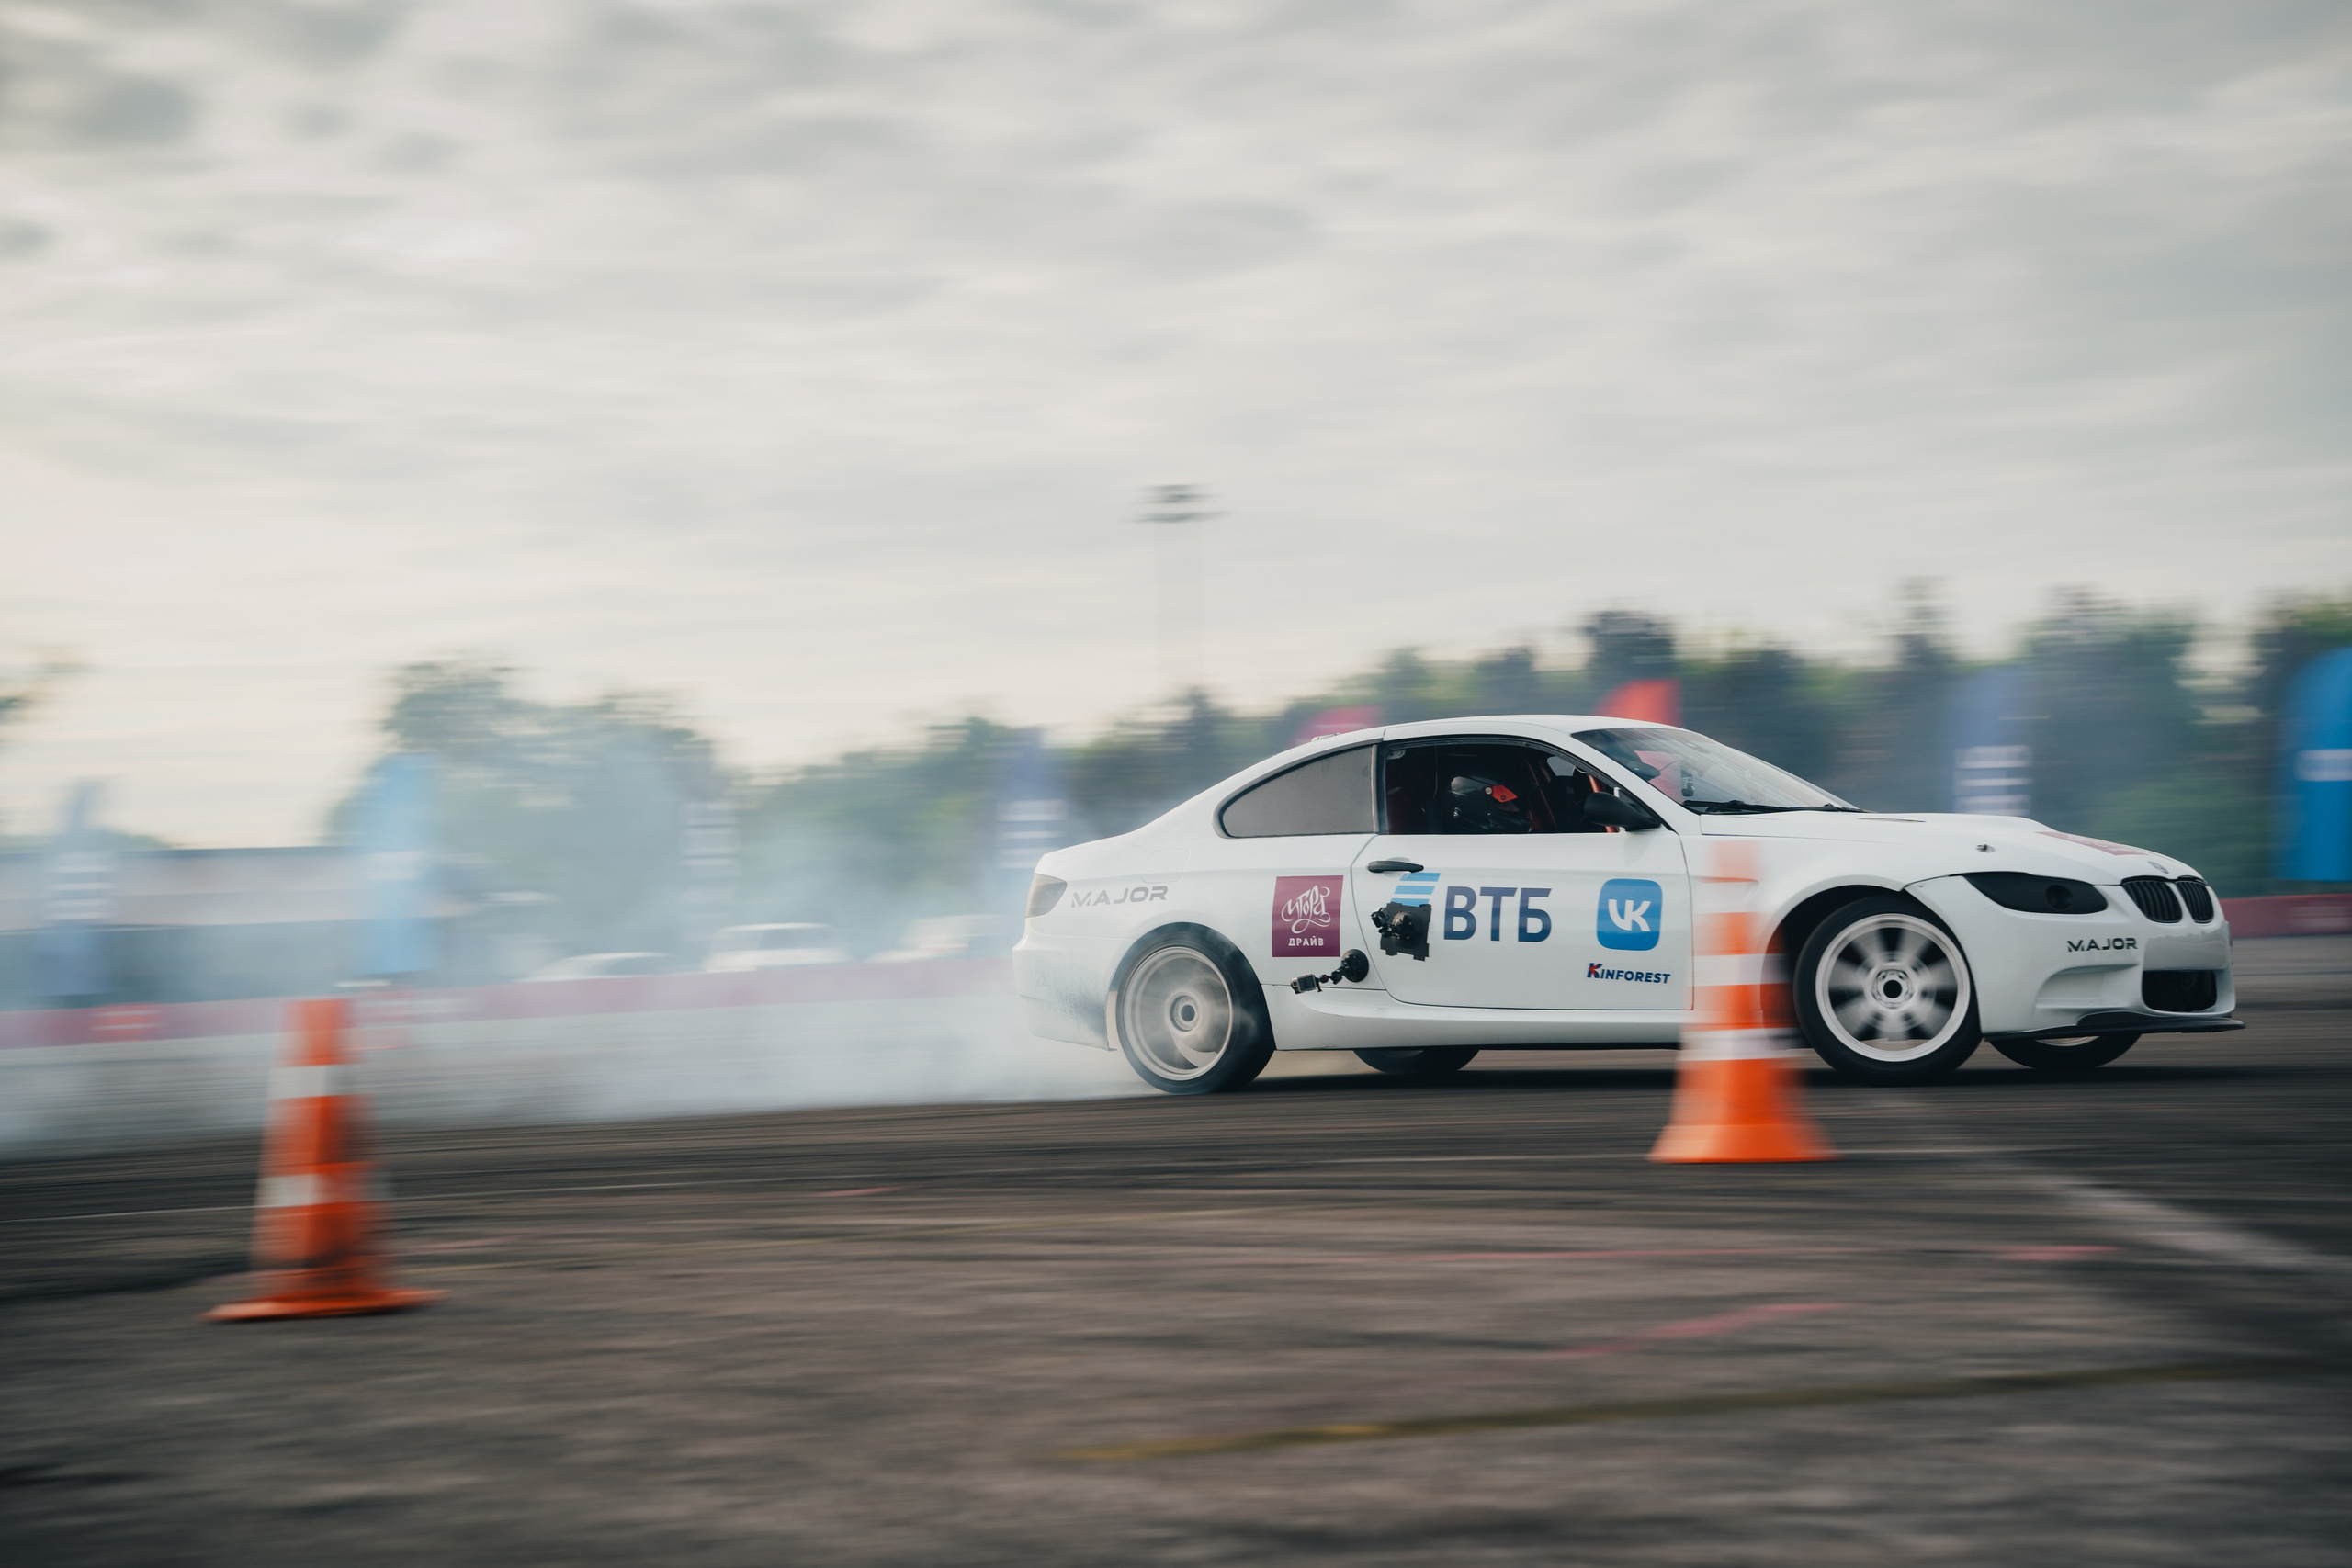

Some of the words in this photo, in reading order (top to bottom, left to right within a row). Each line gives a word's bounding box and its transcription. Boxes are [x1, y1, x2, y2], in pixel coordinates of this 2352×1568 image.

[1071, 886, 1168, 908] MAJOR
[1443, 886, 1553, 942] ВТБ
[1608, 898, 1652, 932] VK
[1288, 935, 1325, 947] ДРАЙВ
[2066, 937, 2138, 953] MAJOR
